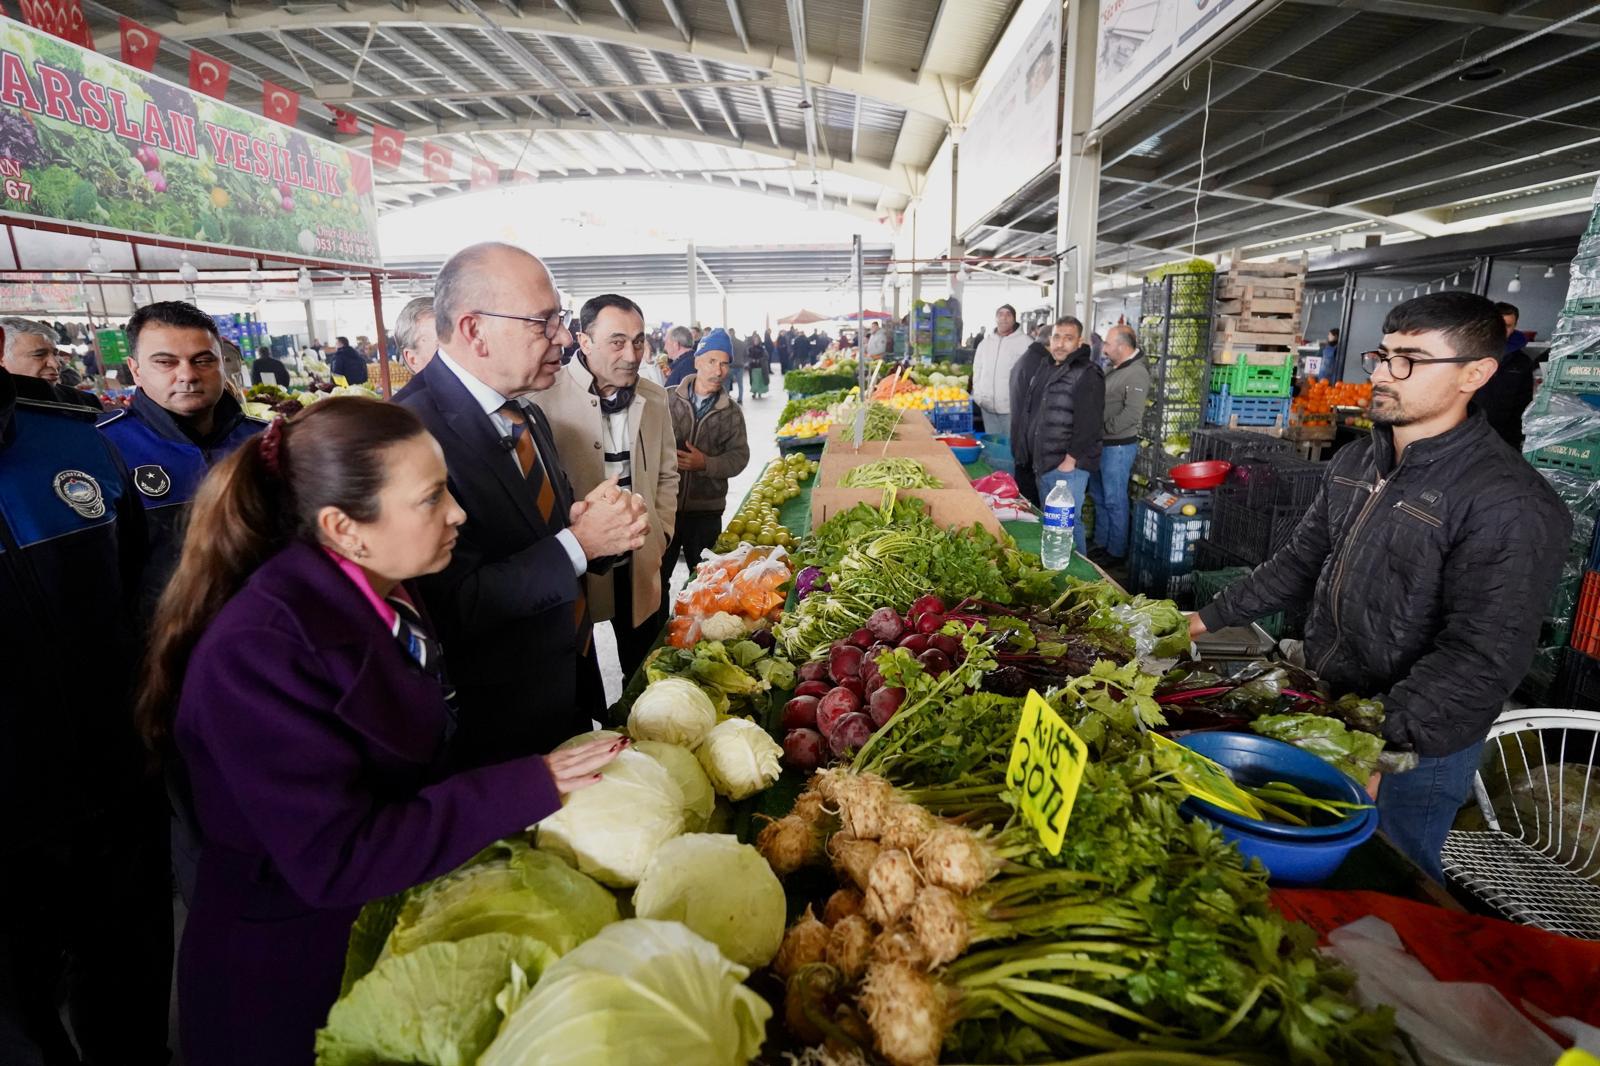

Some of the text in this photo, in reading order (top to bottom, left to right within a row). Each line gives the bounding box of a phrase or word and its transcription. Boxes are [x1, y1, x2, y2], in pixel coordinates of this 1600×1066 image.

[0, 53, 343, 198] ARSLAN YEŞİLLİK
[5, 179, 32, 202] 67
